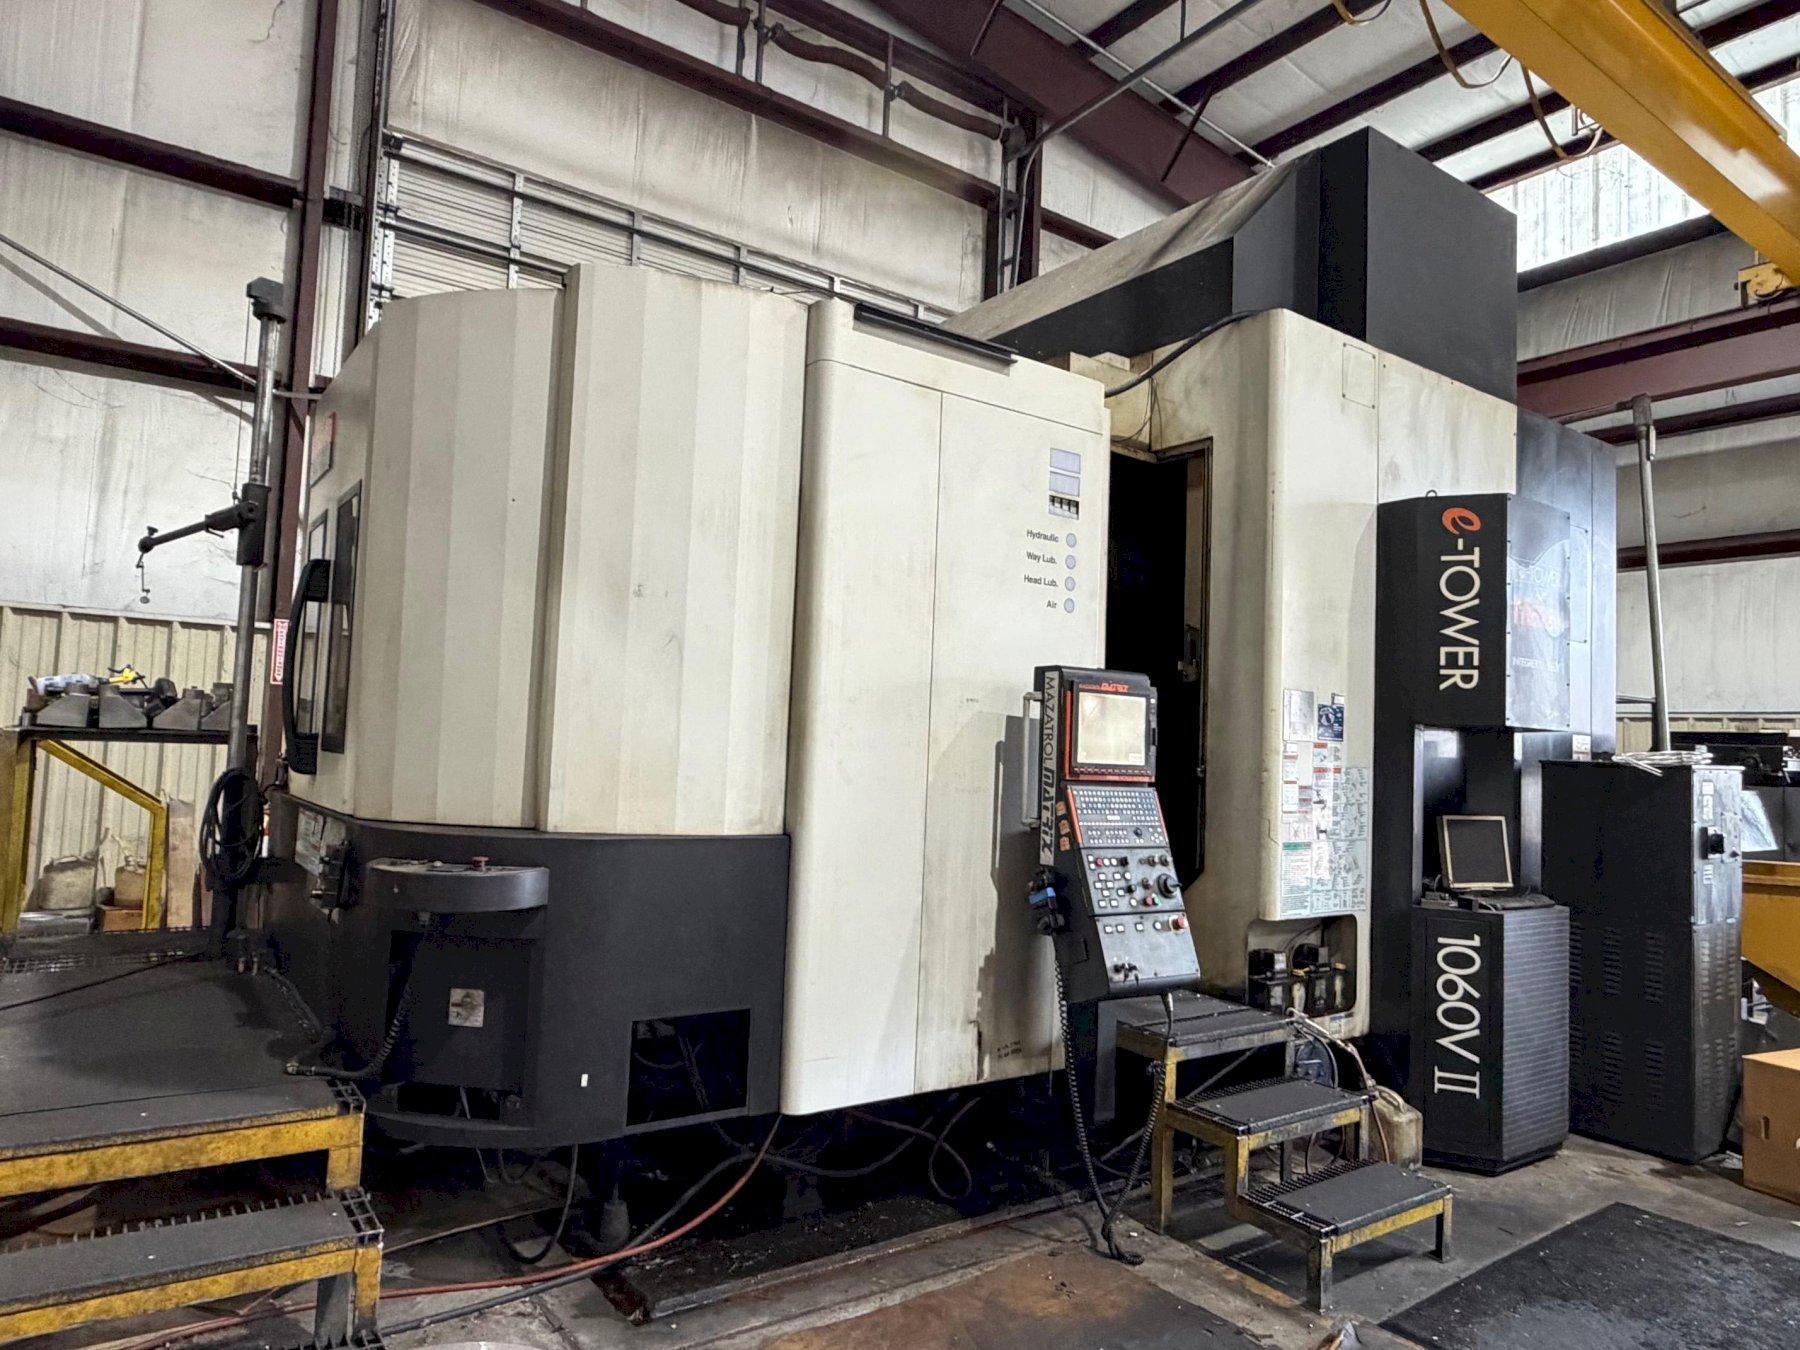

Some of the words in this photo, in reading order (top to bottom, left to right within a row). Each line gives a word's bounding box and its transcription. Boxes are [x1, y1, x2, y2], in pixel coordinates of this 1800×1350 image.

[1026, 528, 1059, 543] Hydraulic
[1026, 550, 1042, 563] Way
[1042, 554, 1058, 565] Lub.
[1023, 573, 1042, 585] Head
[1043, 577, 1059, 588] Lub.
[1046, 599, 1057, 609] Air
[1439, 507, 1482, 691] e-TOWER
[1043, 676, 1055, 765] MAZATROL
[1435, 933, 1482, 1064] 1060V
[1433, 1065, 1481, 1100] II
